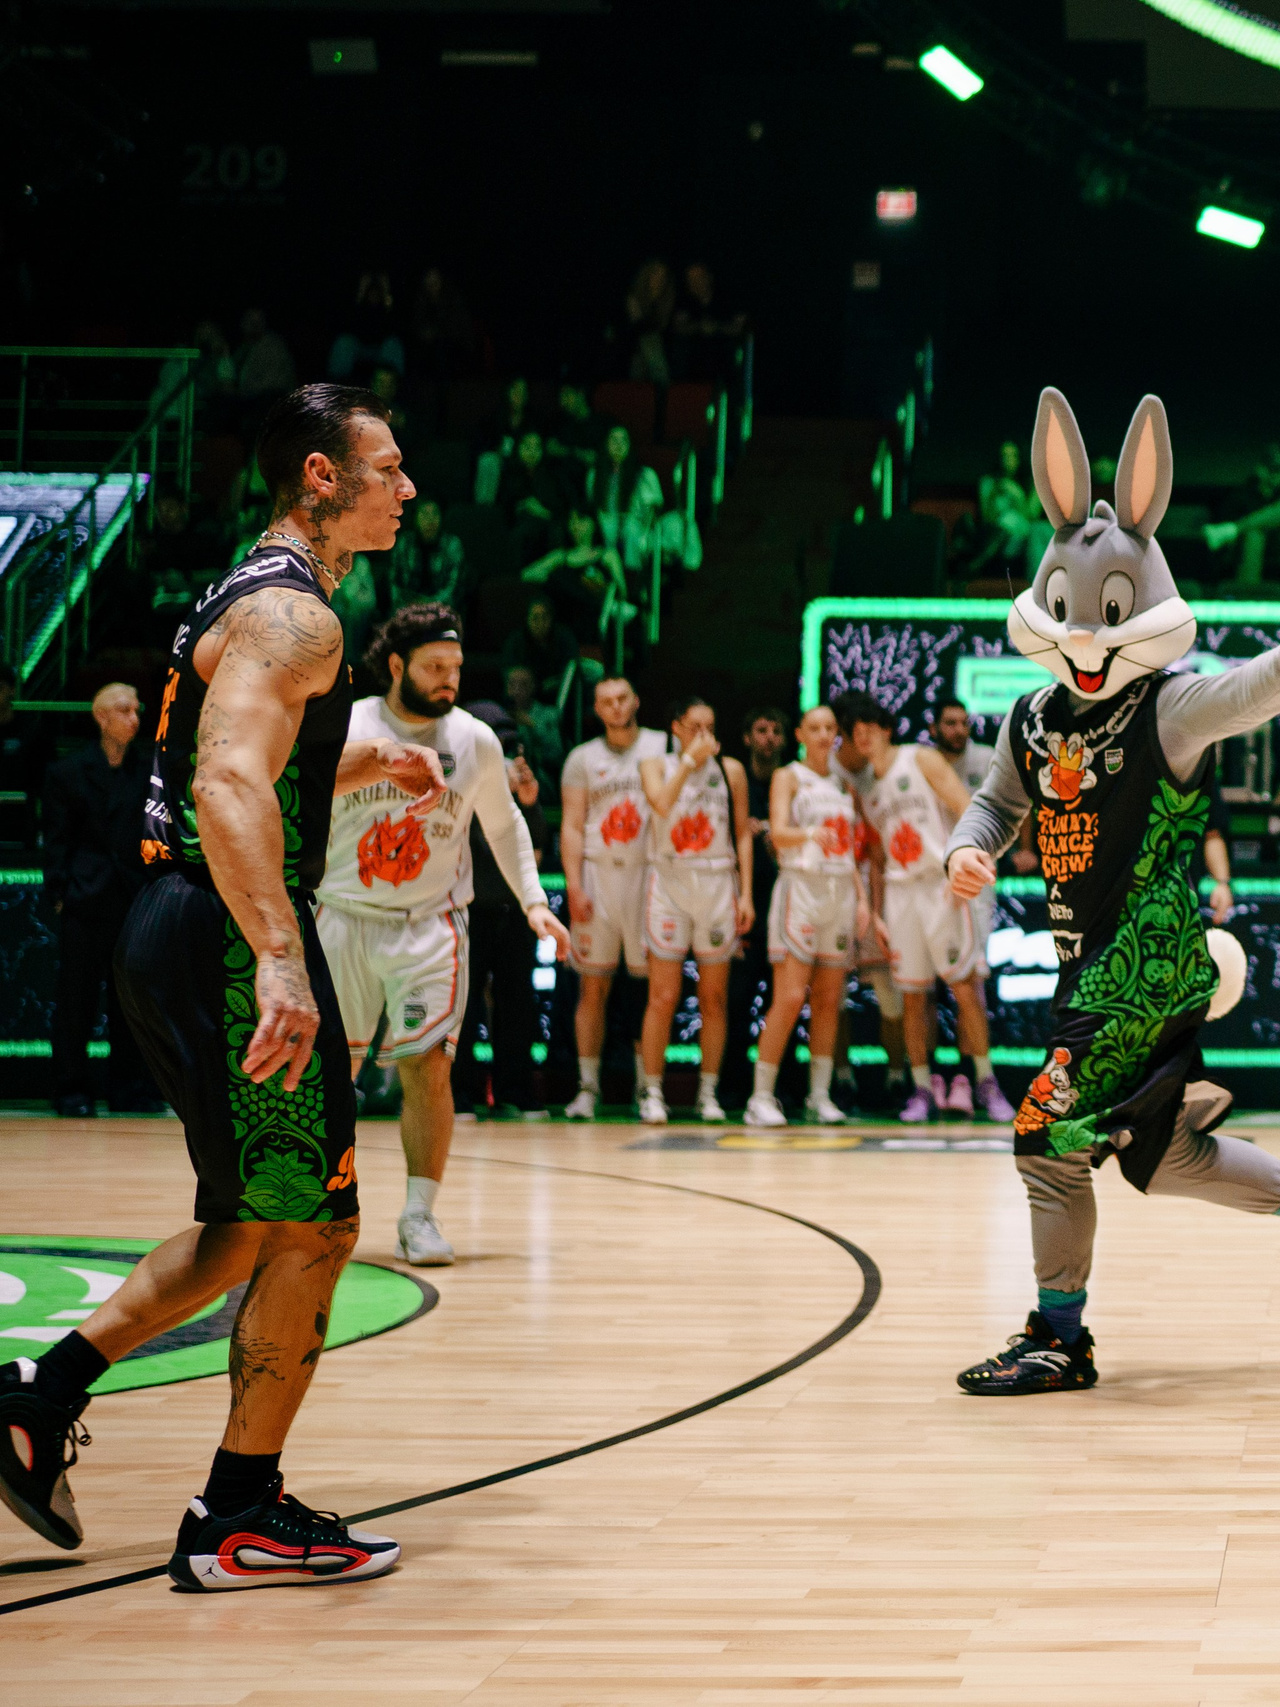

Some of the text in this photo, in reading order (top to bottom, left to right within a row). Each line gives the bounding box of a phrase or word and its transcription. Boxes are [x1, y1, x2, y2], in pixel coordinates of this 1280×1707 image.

[182, 142, 287, 190] 209
[1038, 804, 1099, 835] FUNNY
[1037, 832, 1095, 855] DANCE
